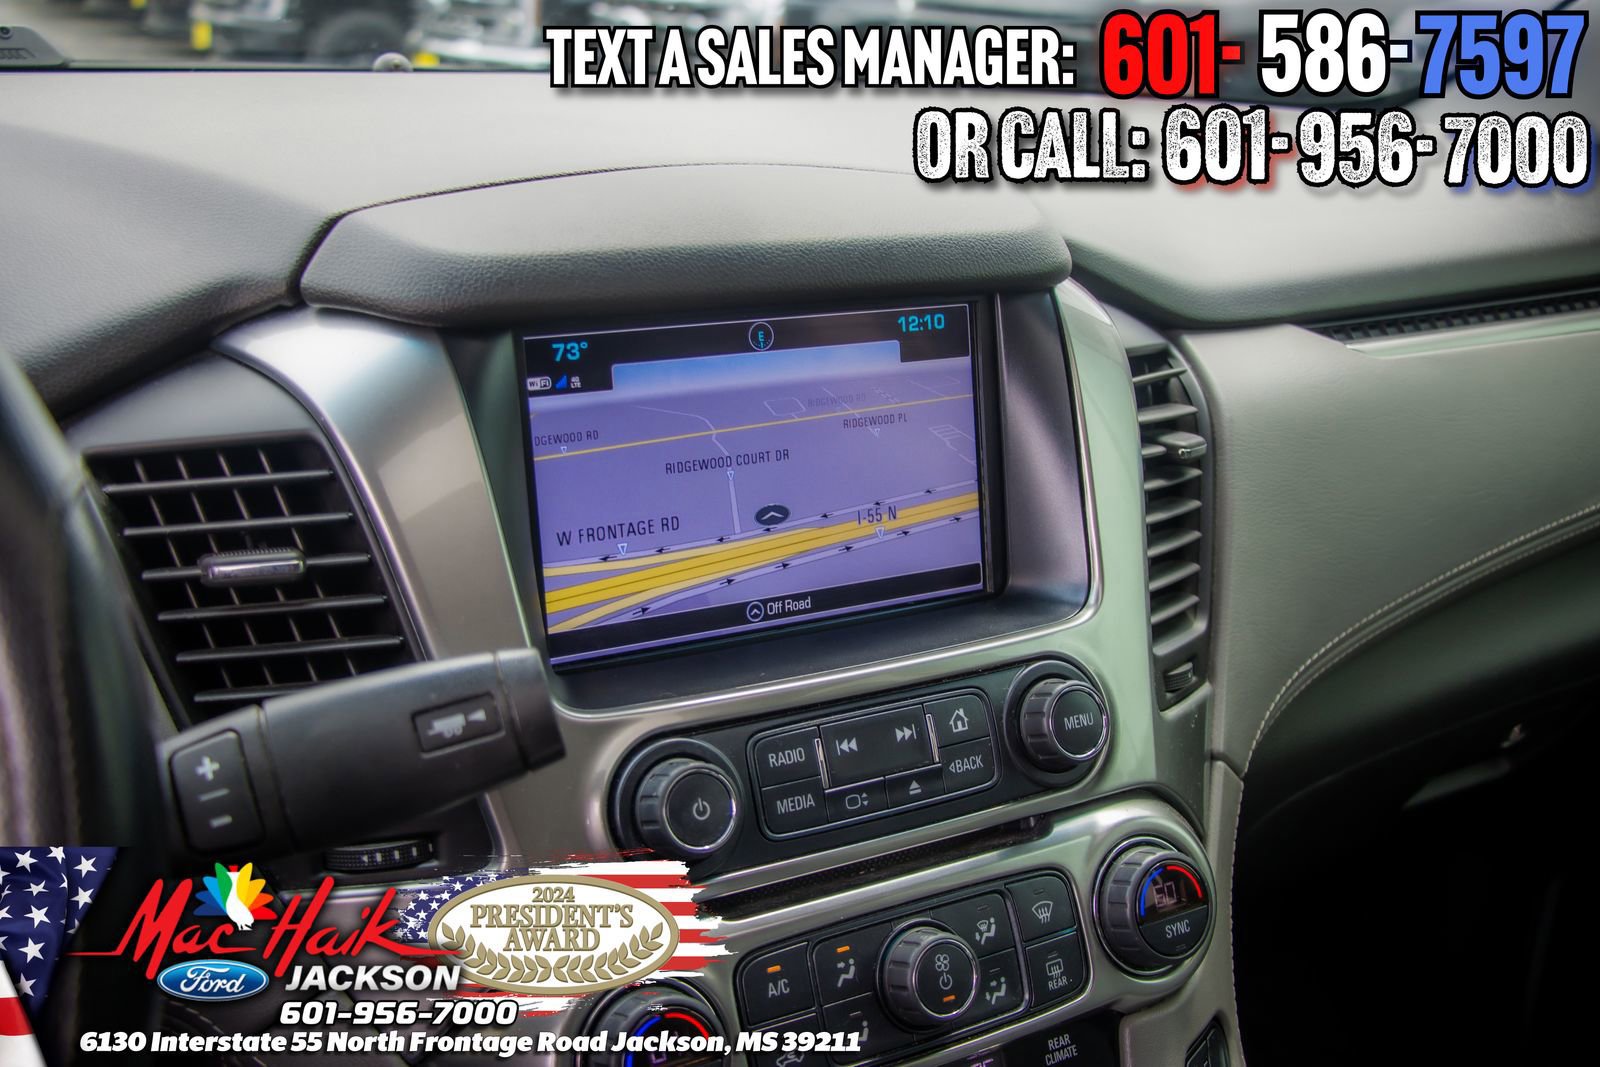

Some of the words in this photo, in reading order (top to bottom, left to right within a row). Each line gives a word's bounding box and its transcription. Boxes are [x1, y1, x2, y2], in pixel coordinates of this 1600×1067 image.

[897, 313, 945, 333] 12:10
[551, 340, 589, 362] 73°
[843, 414, 895, 429] RIDGEWOOD
[898, 413, 908, 423] PL
[586, 430, 599, 441] RD
[665, 455, 732, 475] RIDGEWOOD
[735, 451, 771, 467] COURT
[775, 449, 790, 461] DR
[857, 509, 883, 525] I-55
[888, 506, 897, 520] N
[556, 530, 572, 546] W
[578, 519, 655, 544] FRONTAGE
[661, 516, 680, 532] RD
[767, 601, 783, 616] Off
[785, 597, 811, 612] Road
[1064, 712, 1094, 732] MENU
[768, 747, 806, 768] RADIO
[955, 754, 984, 773] BACK
[776, 793, 815, 815] MEDIA
[1165, 919, 1190, 938] SYNC
[768, 978, 790, 998] A/C
[1048, 976, 1068, 990] REAR
[1047, 1034, 1070, 1049] REAR
[1045, 1047, 1078, 1066] CLIMATE
